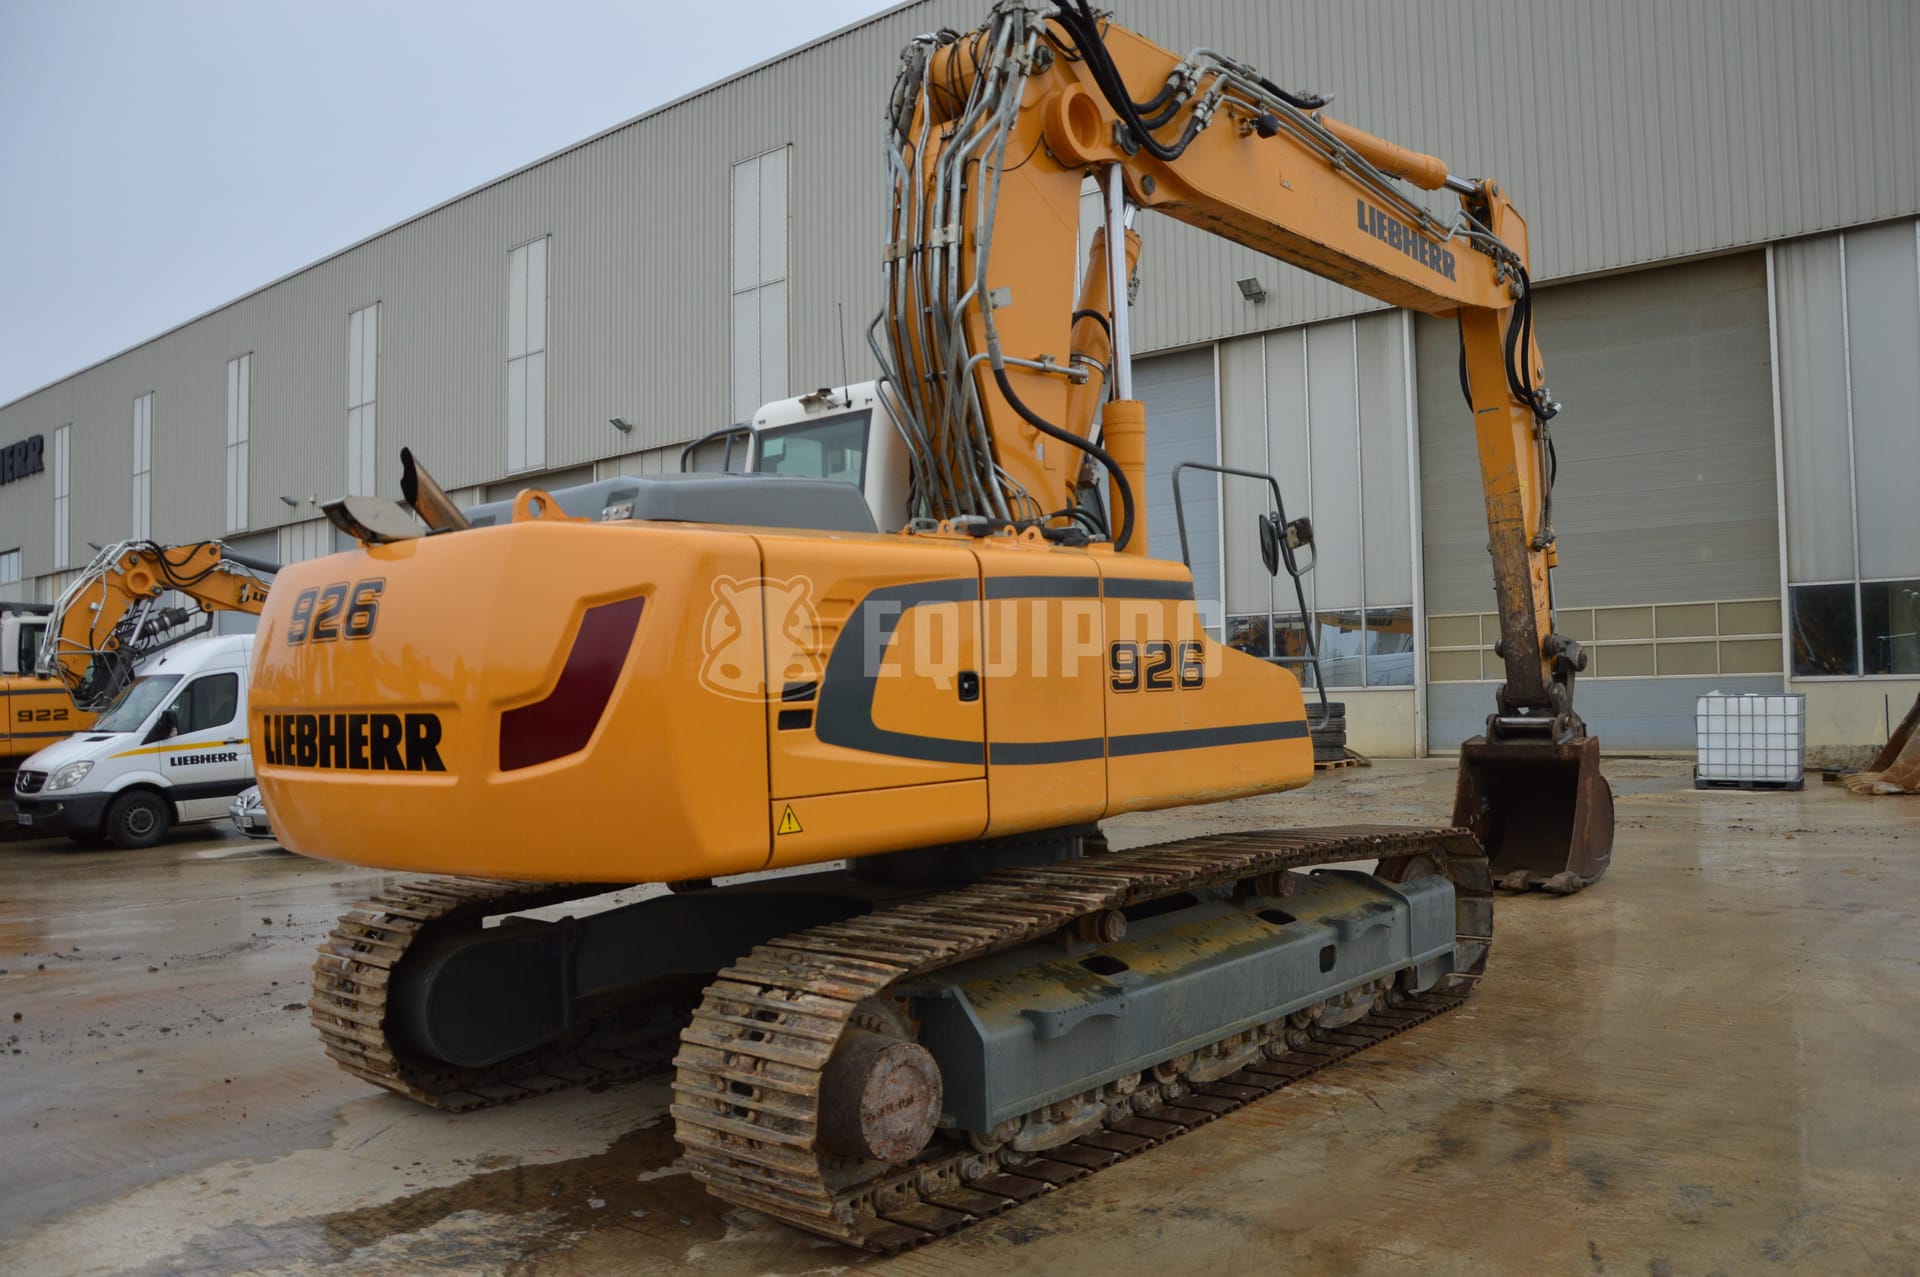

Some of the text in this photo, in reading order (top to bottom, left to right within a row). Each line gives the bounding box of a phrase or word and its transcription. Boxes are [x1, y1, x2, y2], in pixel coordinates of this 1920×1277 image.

[1358, 199, 1456, 282] LIEBHERR
[288, 578, 385, 645] 926
[1110, 640, 1205, 693] 926
[17, 709, 69, 722] 922
[265, 713, 447, 772] LIEBHERR
[170, 752, 238, 766] LIEBHERR
